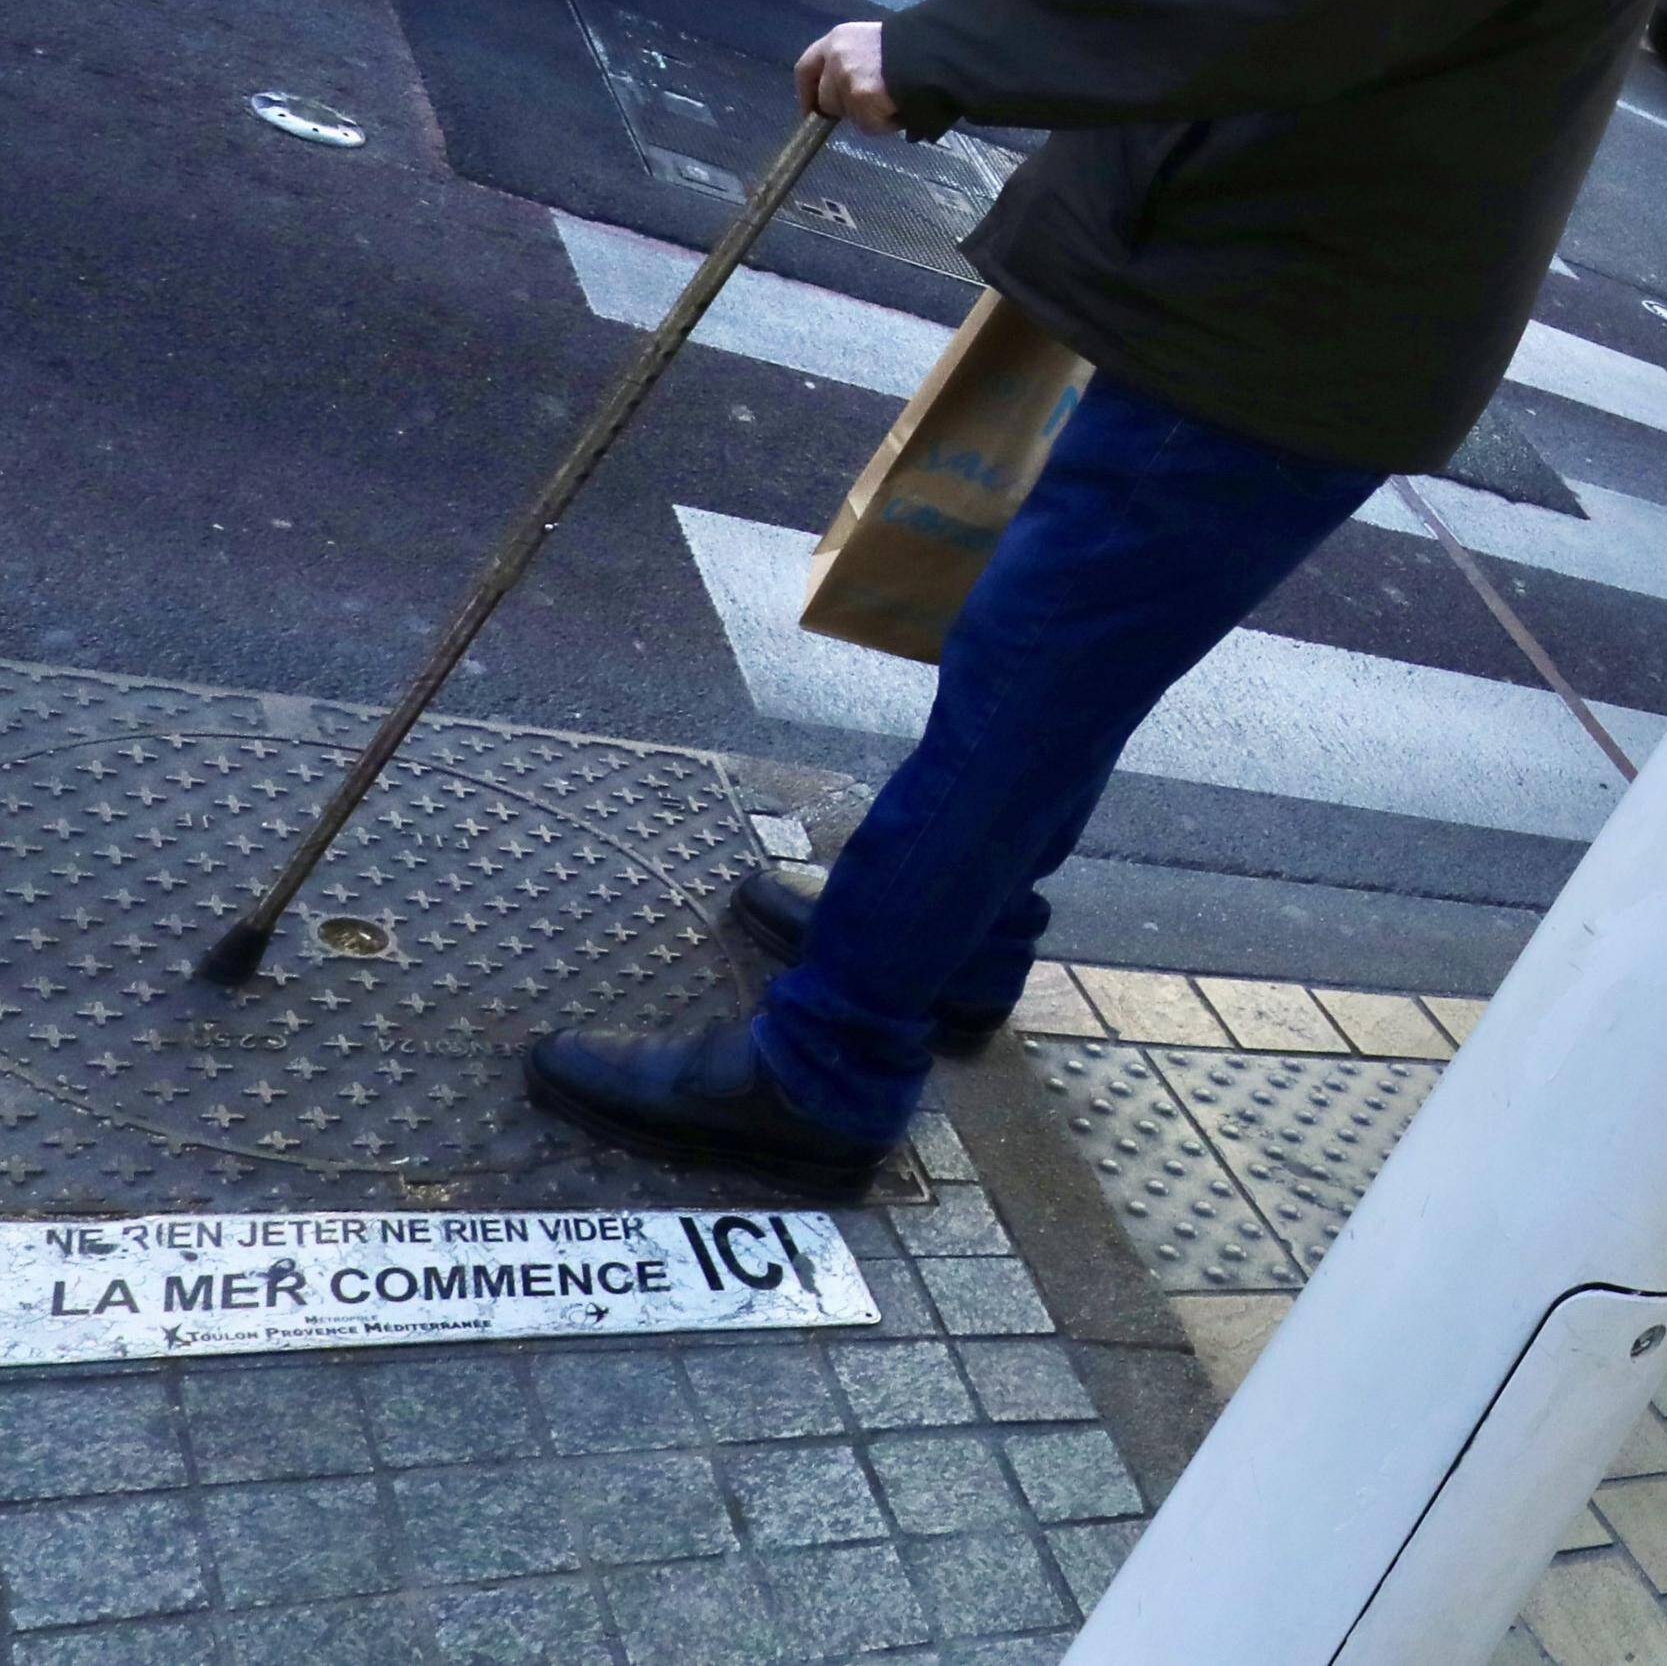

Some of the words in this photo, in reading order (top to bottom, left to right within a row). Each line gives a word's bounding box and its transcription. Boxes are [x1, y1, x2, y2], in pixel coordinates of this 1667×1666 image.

[46, 1227, 105, 1255] NE
[122, 1220, 222, 1252] RIEN
[237, 1217, 368, 1249] JETER
[381, 1218, 432, 1244] NE
[444, 1216, 529, 1244] RIEN
[538, 1216, 646, 1243] VIDER
[679, 1215, 814, 1291] ICI
[50, 1278, 140, 1317] LA
[163, 1271, 307, 1313] MER
[330, 1260, 671, 1304] COMMENCE
[265, 1326, 358, 1339] PROVENCE
